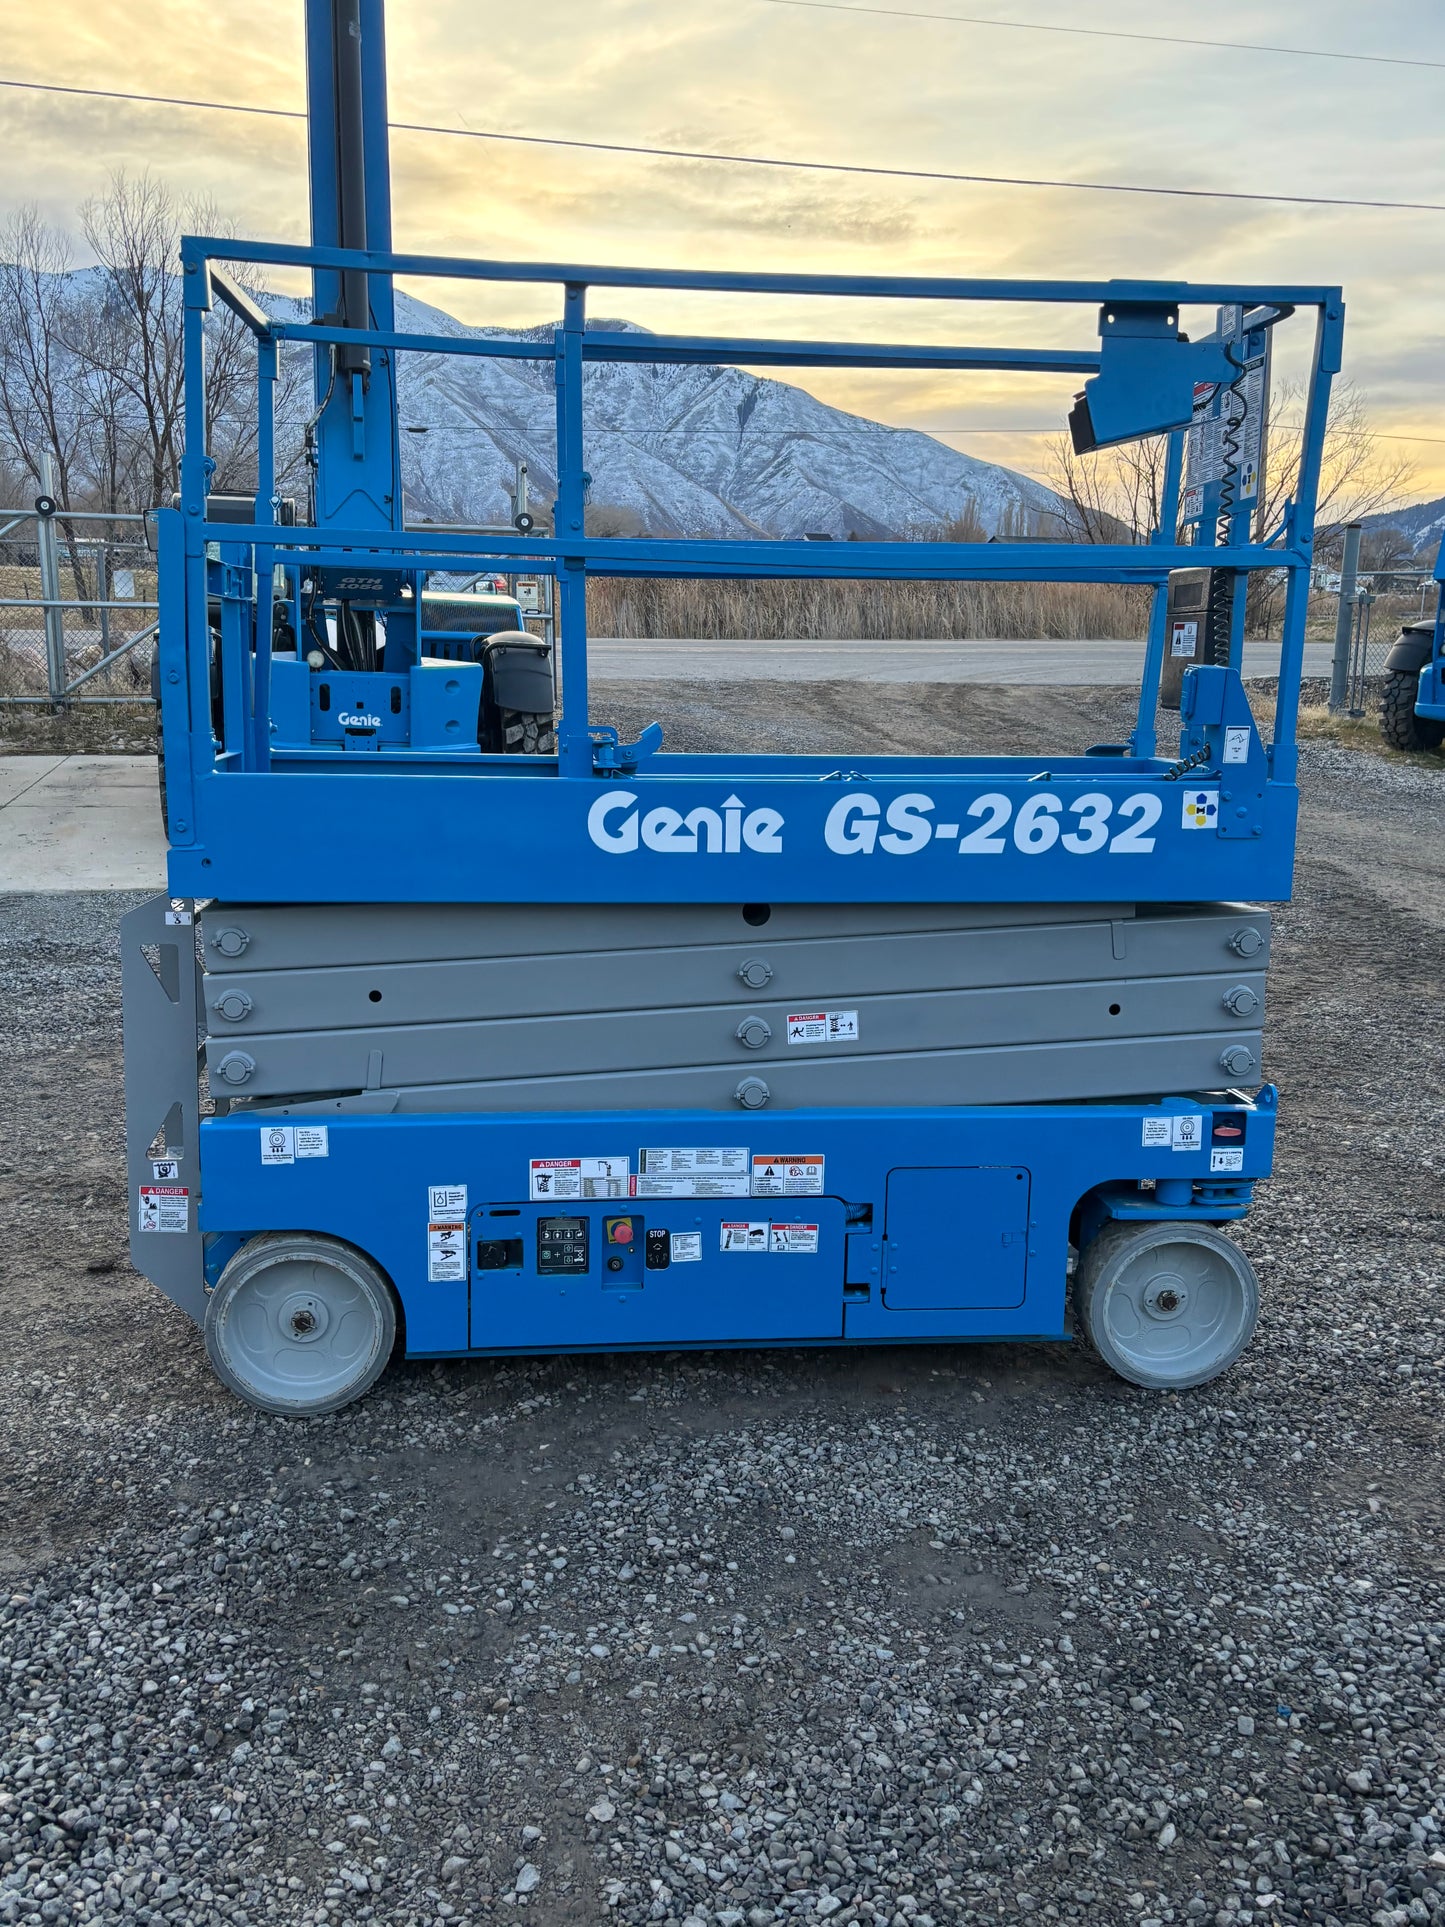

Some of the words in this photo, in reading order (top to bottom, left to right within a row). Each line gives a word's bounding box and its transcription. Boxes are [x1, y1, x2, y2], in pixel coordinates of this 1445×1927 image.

[338, 712, 382, 727] Genie
[588, 790, 785, 854] Genie
[824, 793, 1163, 855] GS-2632
[649, 1230, 666, 1238] STOP
